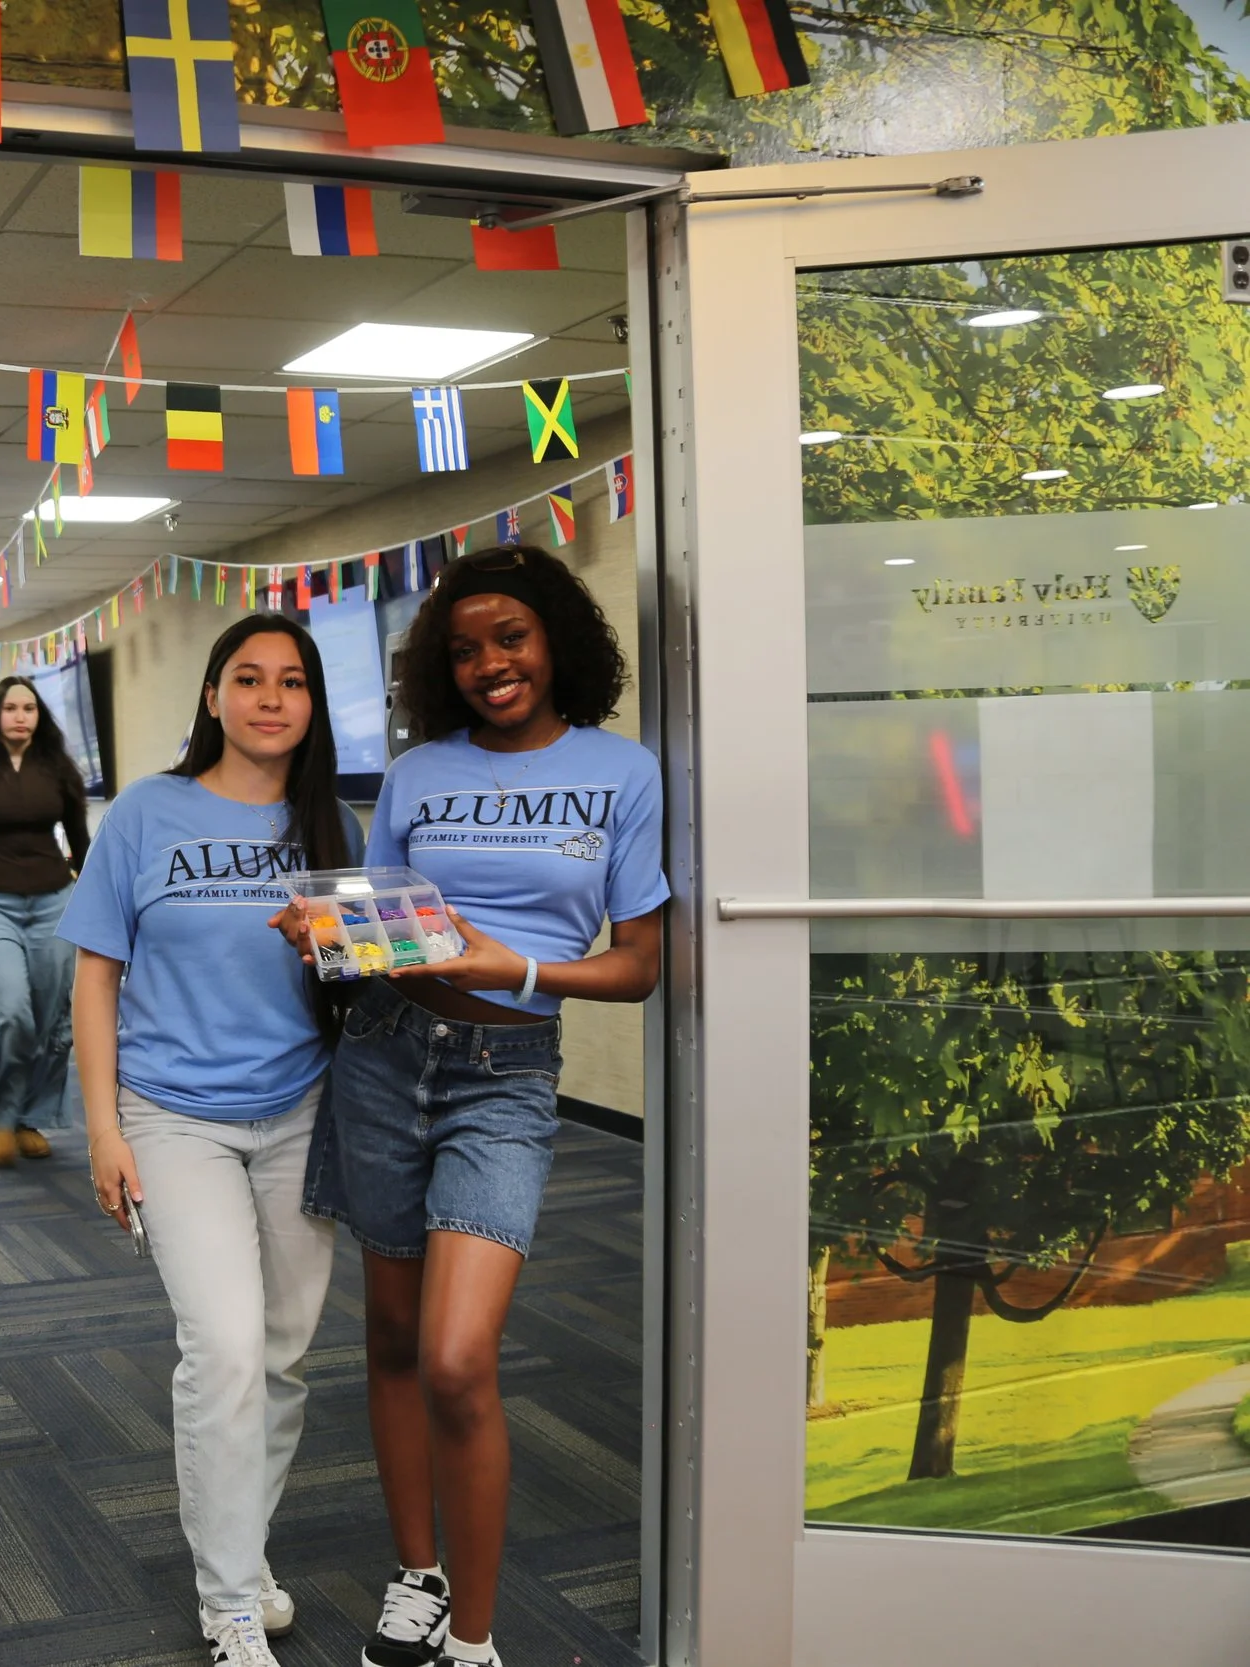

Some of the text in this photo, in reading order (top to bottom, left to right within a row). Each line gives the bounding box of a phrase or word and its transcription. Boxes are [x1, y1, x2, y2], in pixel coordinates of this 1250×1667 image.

[410, 790, 618, 828] ALUMNI
[426, 833, 468, 842] FAMILY
[472, 835, 549, 844] UNIVERSITY
[165, 843, 304, 887] ALUM
[197, 889, 238, 898] FAMILY
[243, 889, 290, 899] UNIVERS
